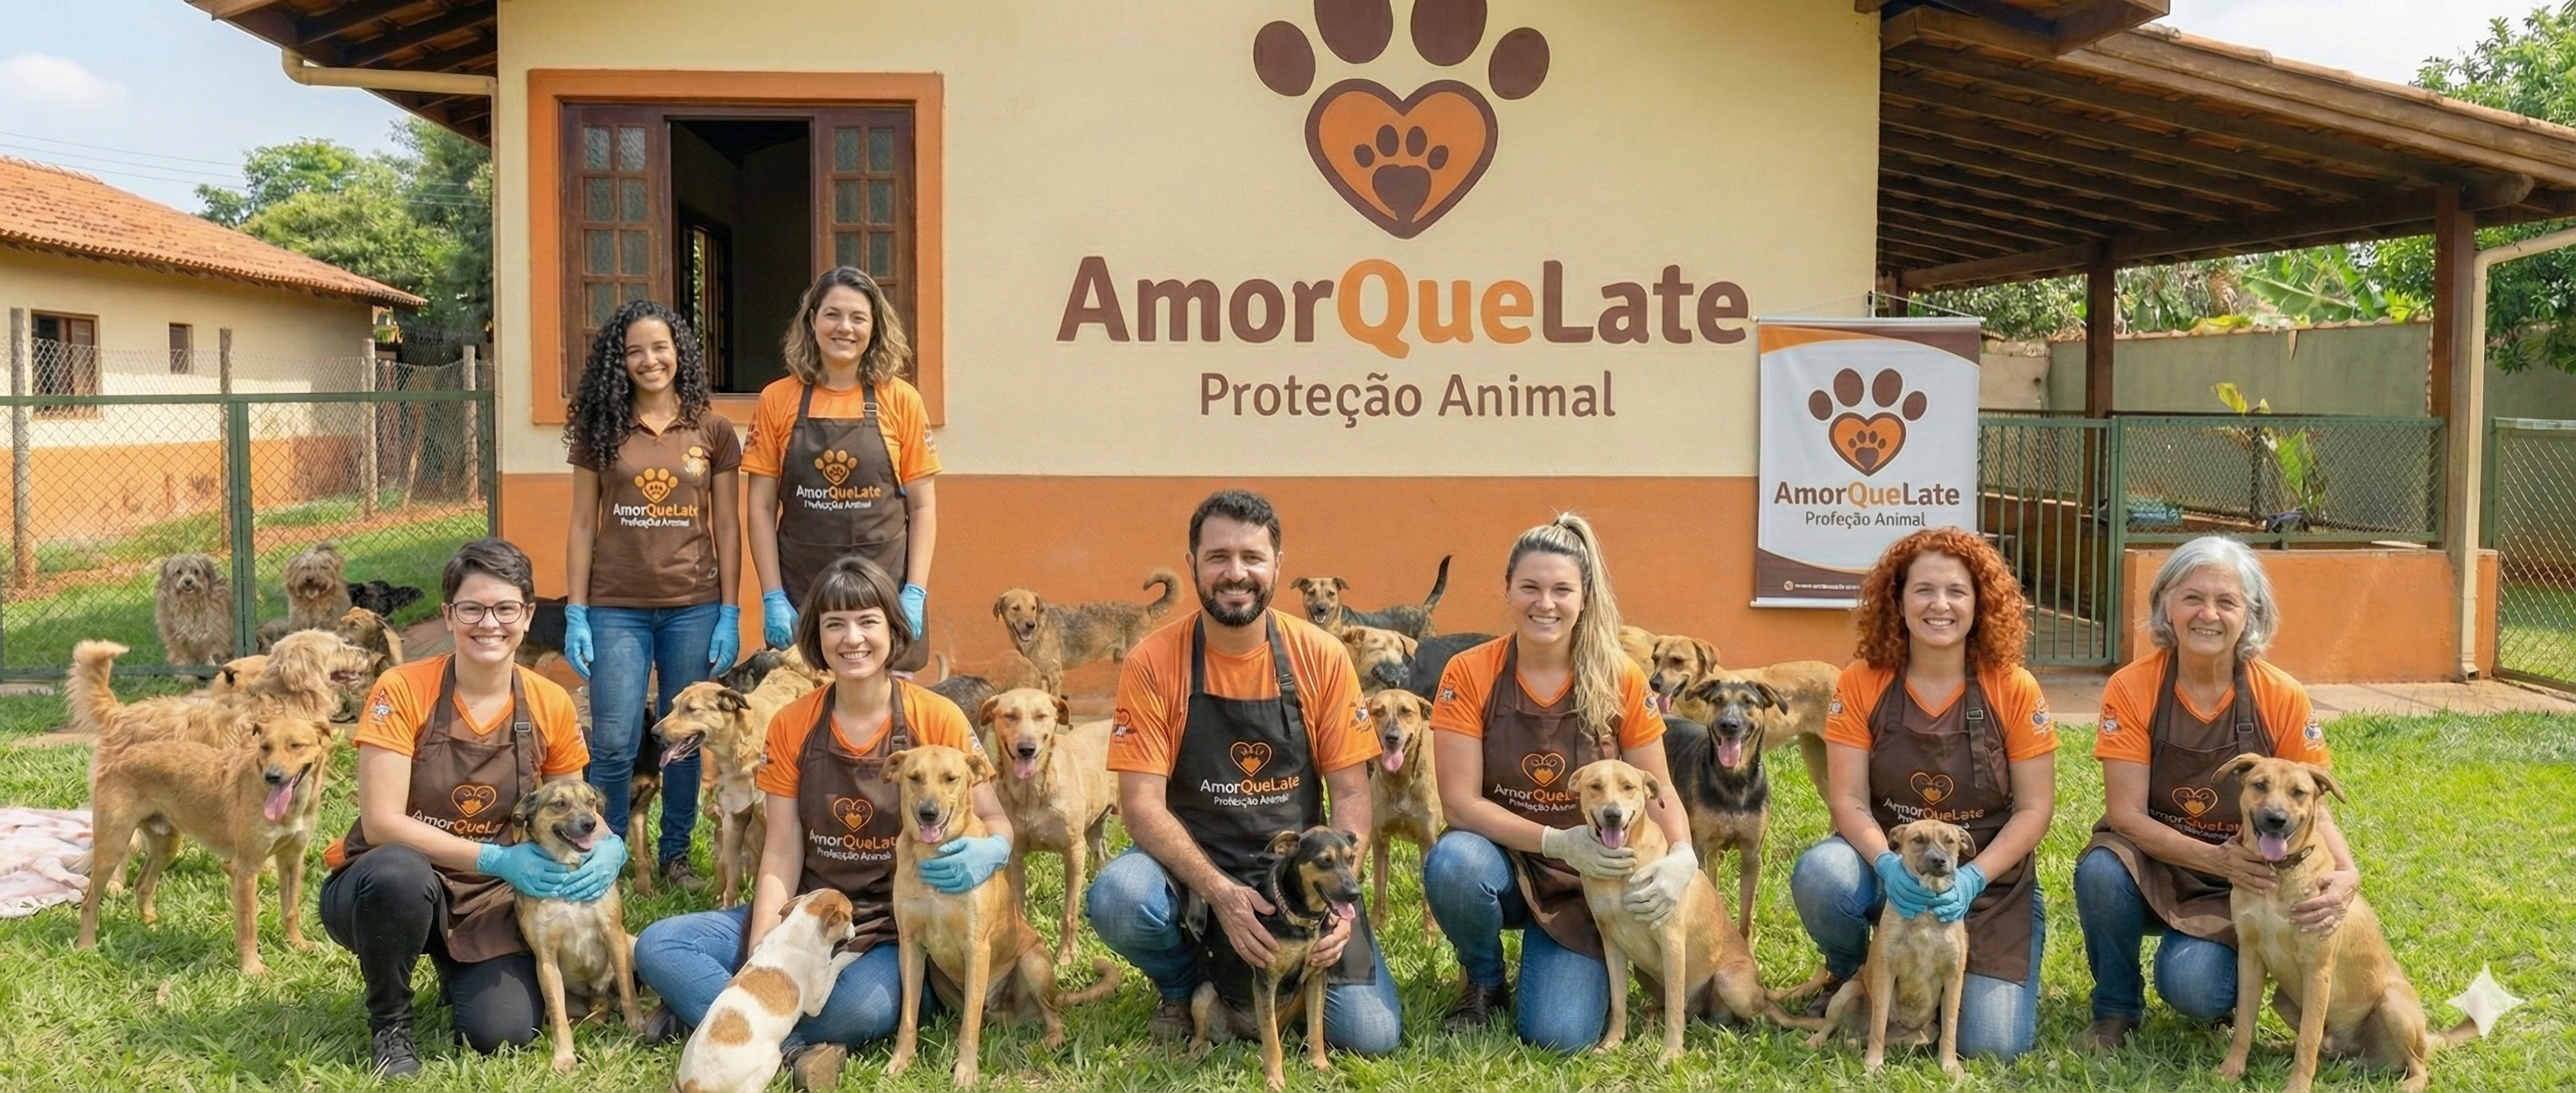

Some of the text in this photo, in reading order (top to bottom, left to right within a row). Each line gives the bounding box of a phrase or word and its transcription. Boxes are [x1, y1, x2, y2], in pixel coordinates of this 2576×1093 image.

[1056, 255, 1750, 359] AmorQueLate
[1200, 370, 1617, 429] Proteção Animal
[1773, 481, 1960, 509] AmorQueLate
[1875, 512, 1926, 527] Animal
[808, 828, 896, 851] AmorQueLat
